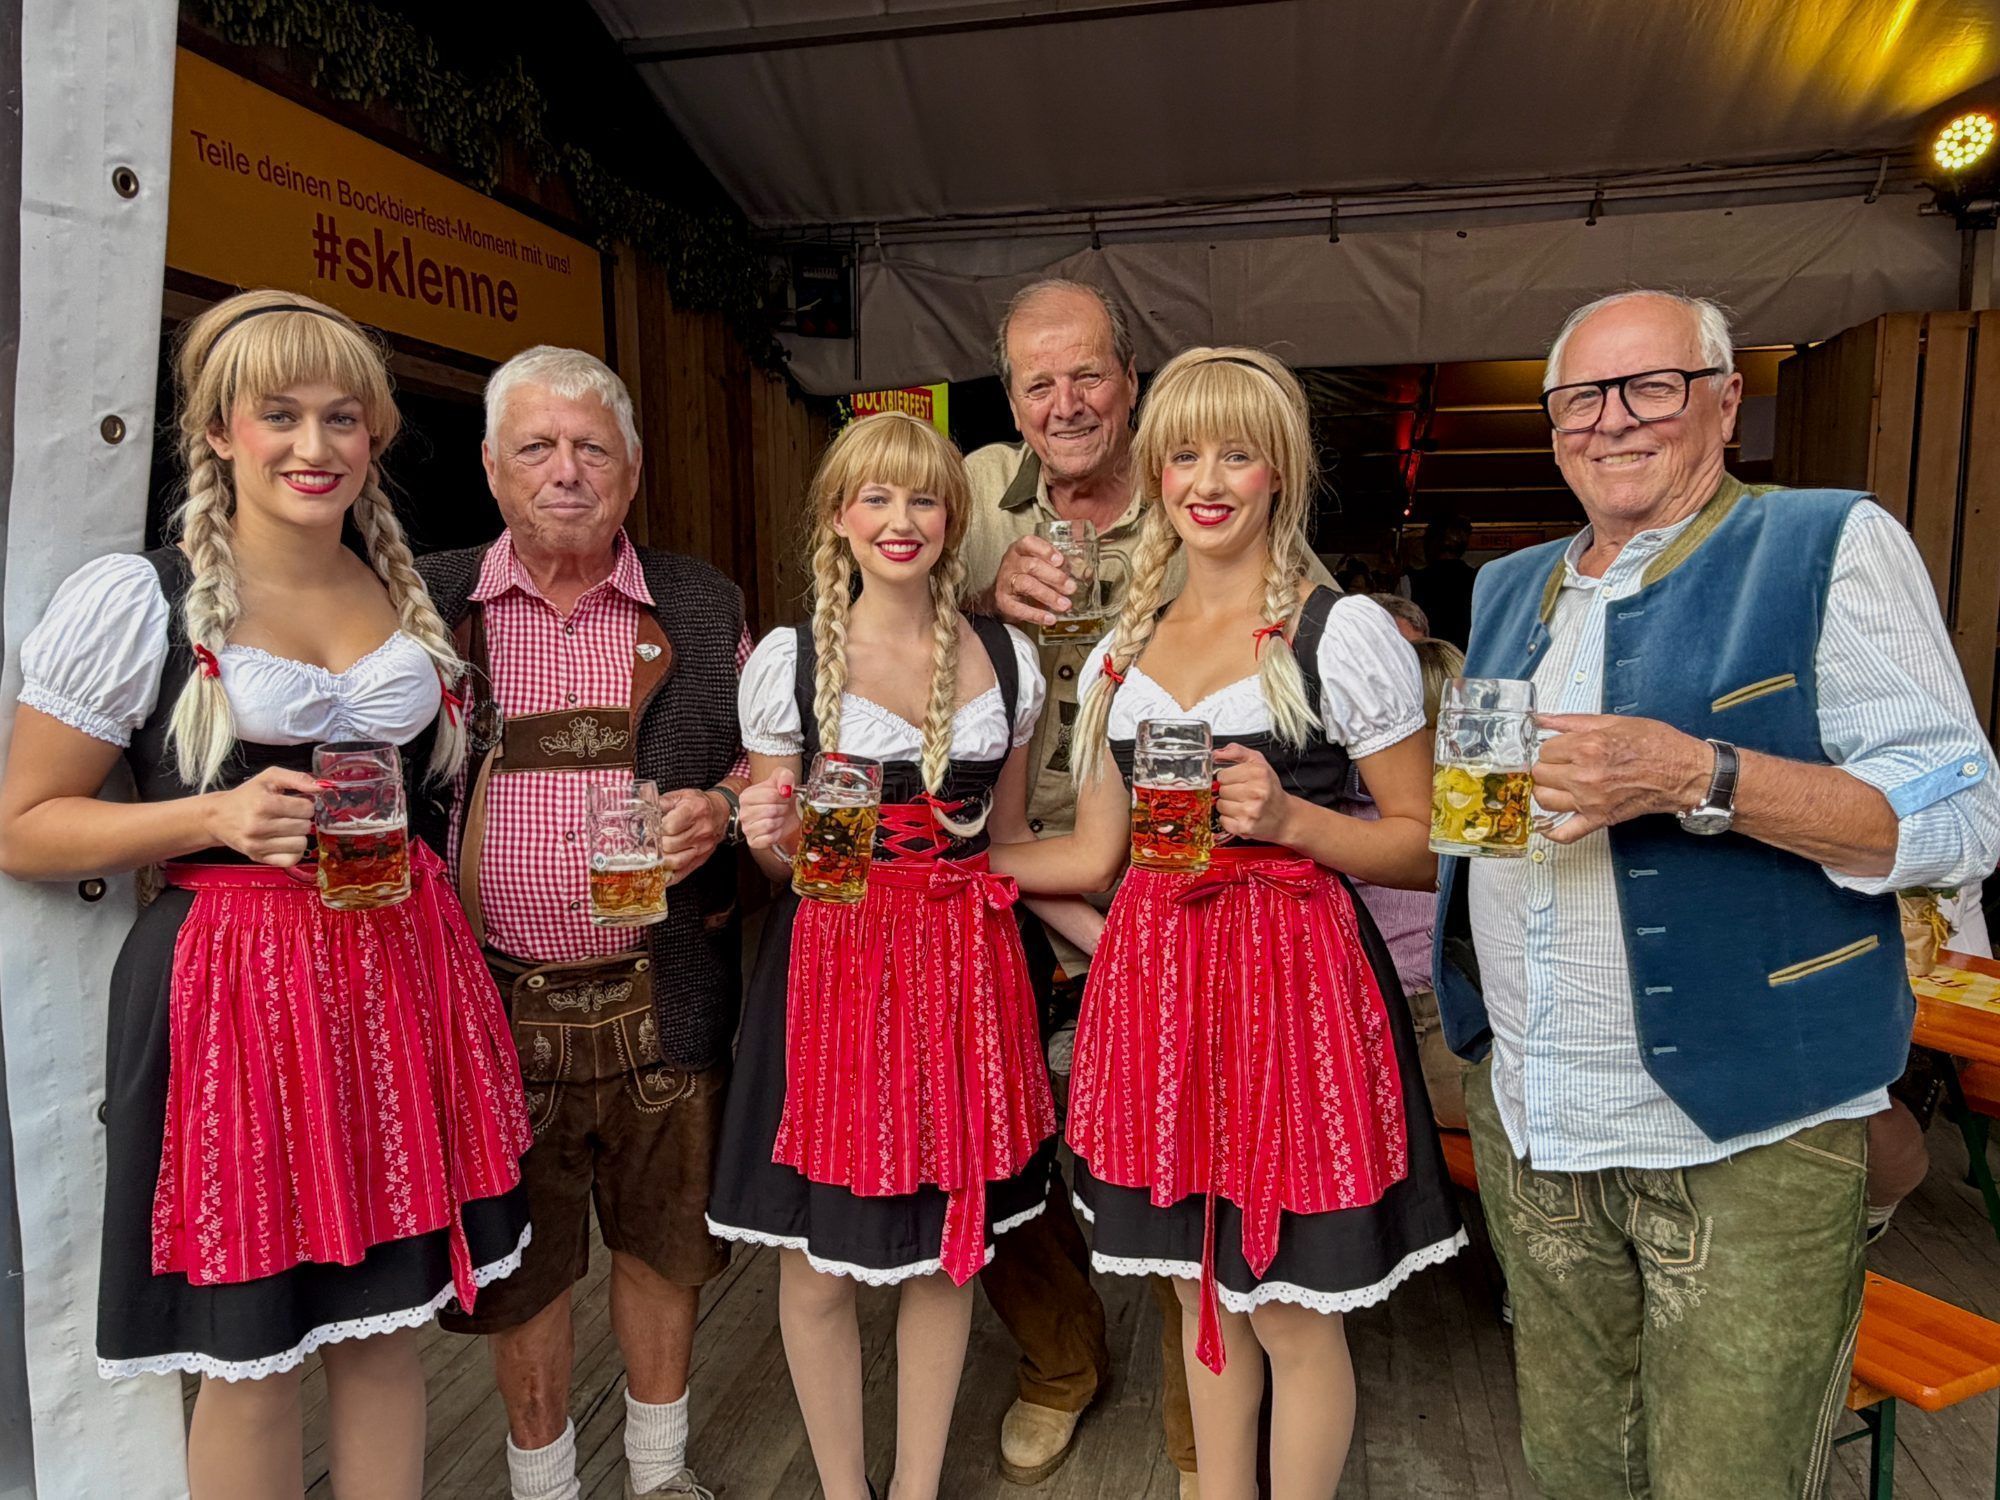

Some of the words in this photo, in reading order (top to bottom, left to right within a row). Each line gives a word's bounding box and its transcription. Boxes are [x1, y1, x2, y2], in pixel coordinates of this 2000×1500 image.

[190, 130, 250, 176] Teile
[257, 155, 331, 201] deinen
[338, 180, 518, 260] Bockbierfest-Moment
[521, 243, 542, 264] mit
[545, 252, 571, 275] uns!
[312, 212, 519, 322] #sklenne
